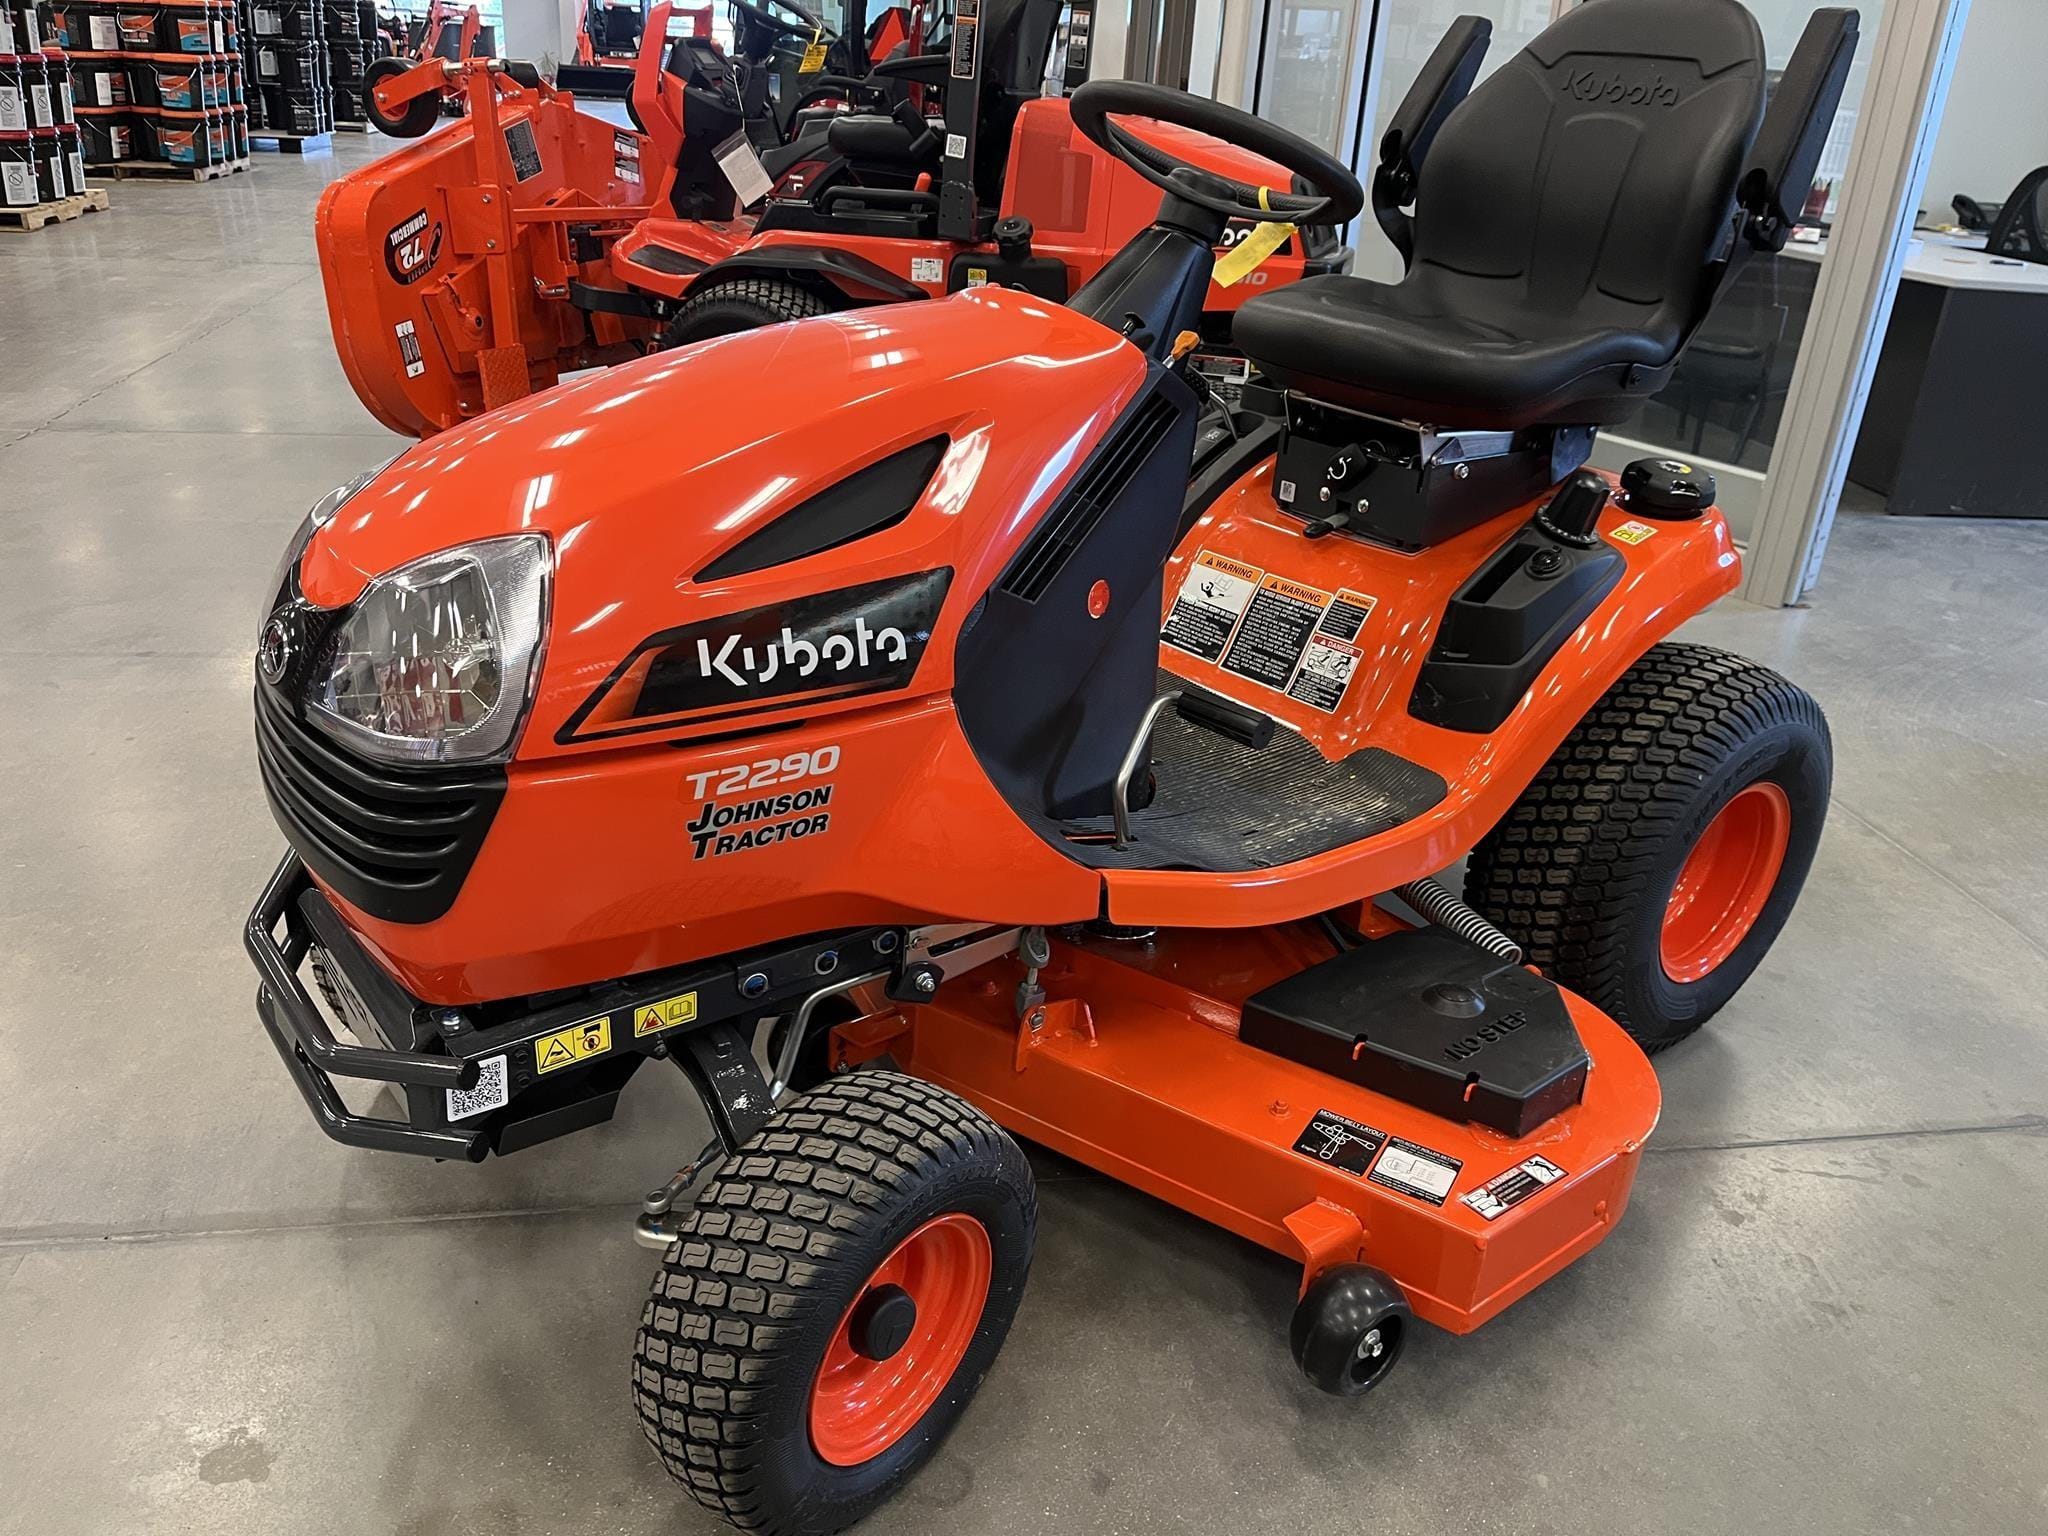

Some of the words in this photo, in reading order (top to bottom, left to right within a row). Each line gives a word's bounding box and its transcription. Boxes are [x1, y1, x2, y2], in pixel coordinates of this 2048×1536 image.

[1562, 69, 1680, 107] Kubota
[390, 212, 428, 247] COMMERCIAL
[400, 237, 425, 270] 72
[1215, 559, 1254, 579] WARNING
[1280, 583, 1322, 603] WARNING
[697, 617, 908, 686] Kubota
[1327, 640, 1355, 655] DANGER
[685, 745, 841, 800] T2290
[687, 784, 834, 833] JOHNSON
[690, 812, 830, 860] TRACTOR
[1444, 1037, 1482, 1061] NO
[1477, 1010, 1527, 1044] STEP
[1319, 1109, 1345, 1122] MOWER
[1344, 1117, 1360, 1129] BELT
[1360, 1124, 1386, 1140] LAYOUT
